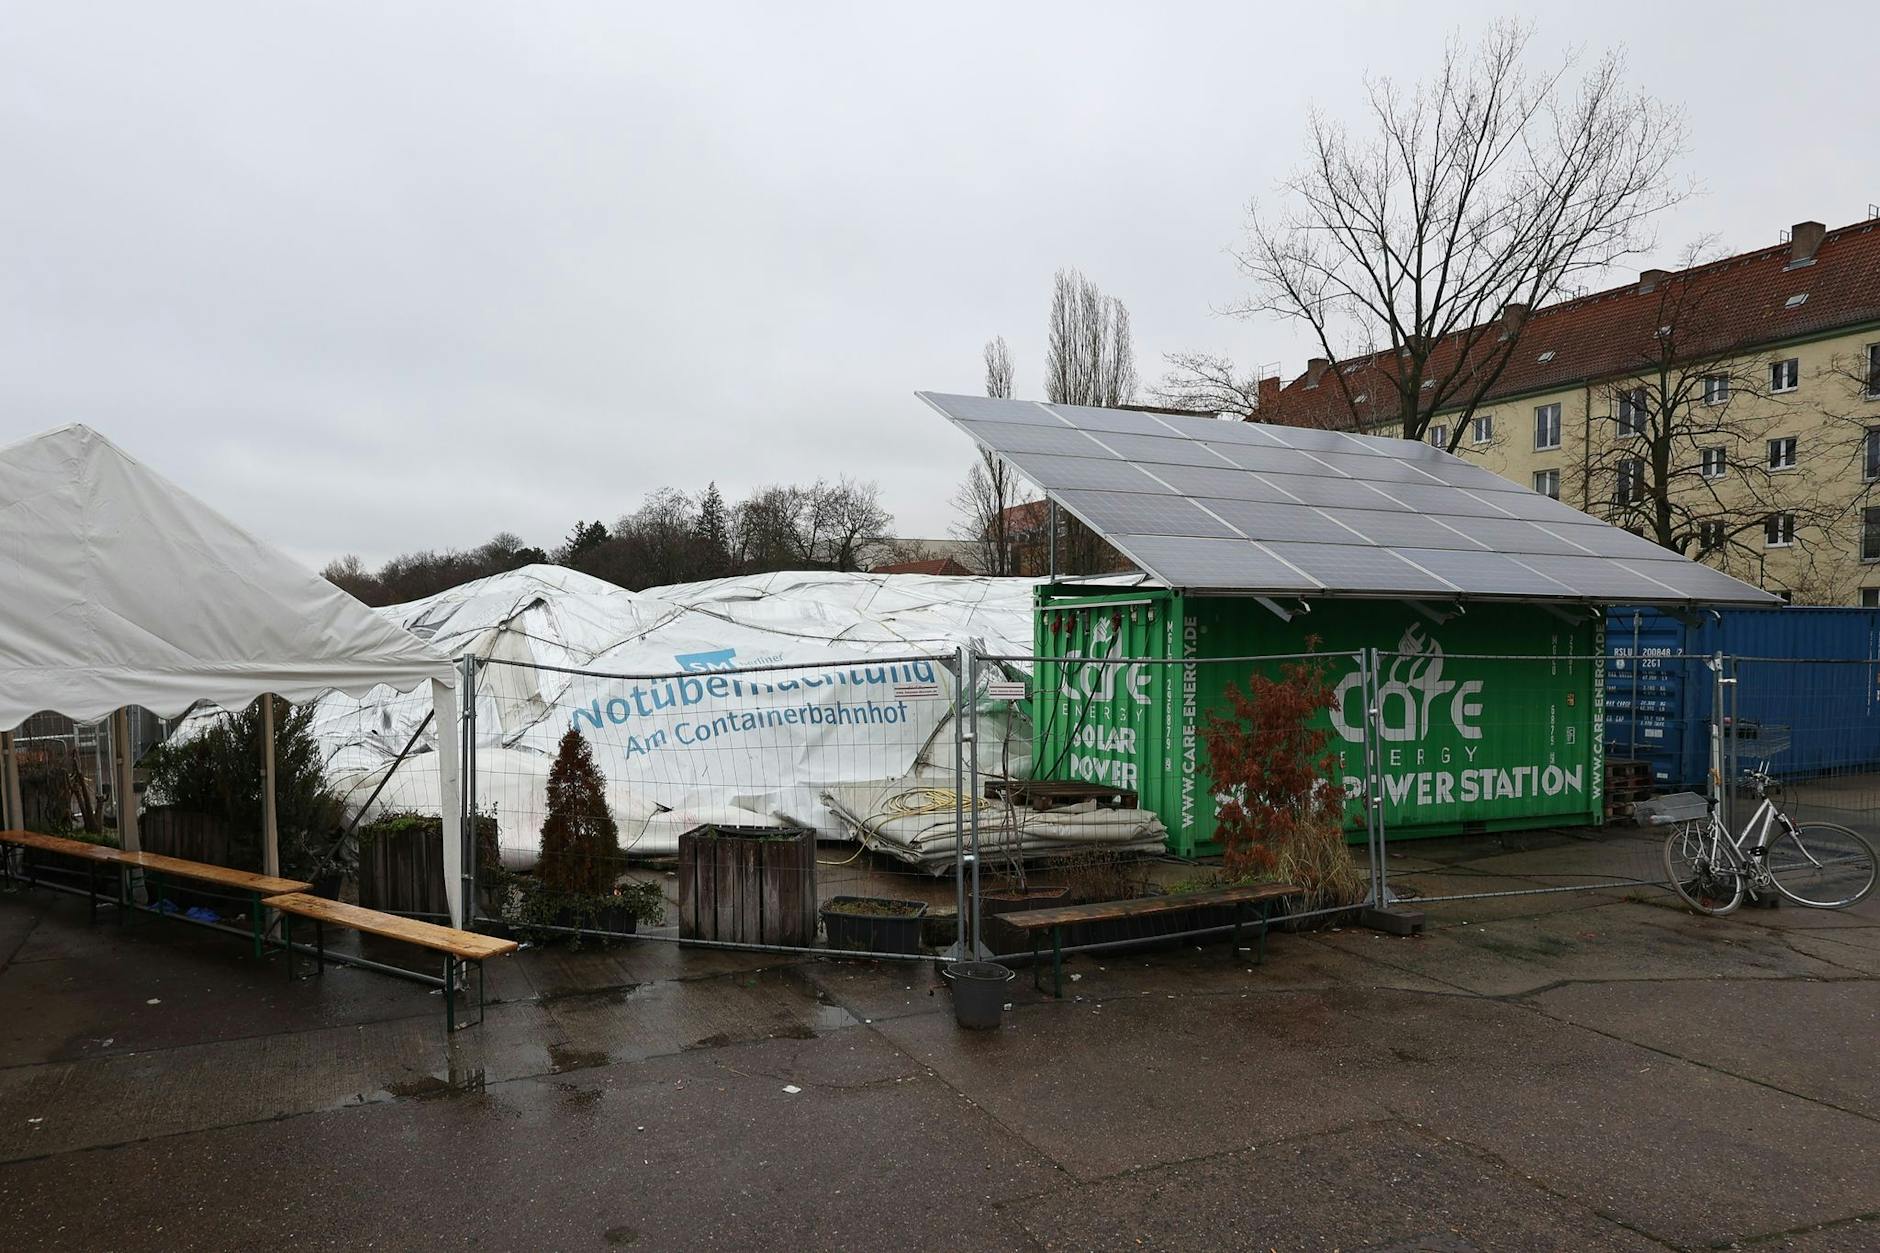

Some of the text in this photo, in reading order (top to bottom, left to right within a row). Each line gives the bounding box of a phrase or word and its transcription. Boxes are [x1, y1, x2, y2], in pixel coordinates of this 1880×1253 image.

[1642, 659, 1661, 668] 22G1
[1062, 703, 1143, 722] ENERGY
[1181, 614, 1198, 829] WWW.CARE-ENERGY.DE
[1592, 623, 1605, 800] WWW.CARE-ENERGY.DE
[625, 701, 908, 760] Am Containerbahnhof
[1073, 722, 1136, 755] SOLAR
[1070, 753, 1138, 790] POWER
[1340, 746, 1477, 767] EERGY
